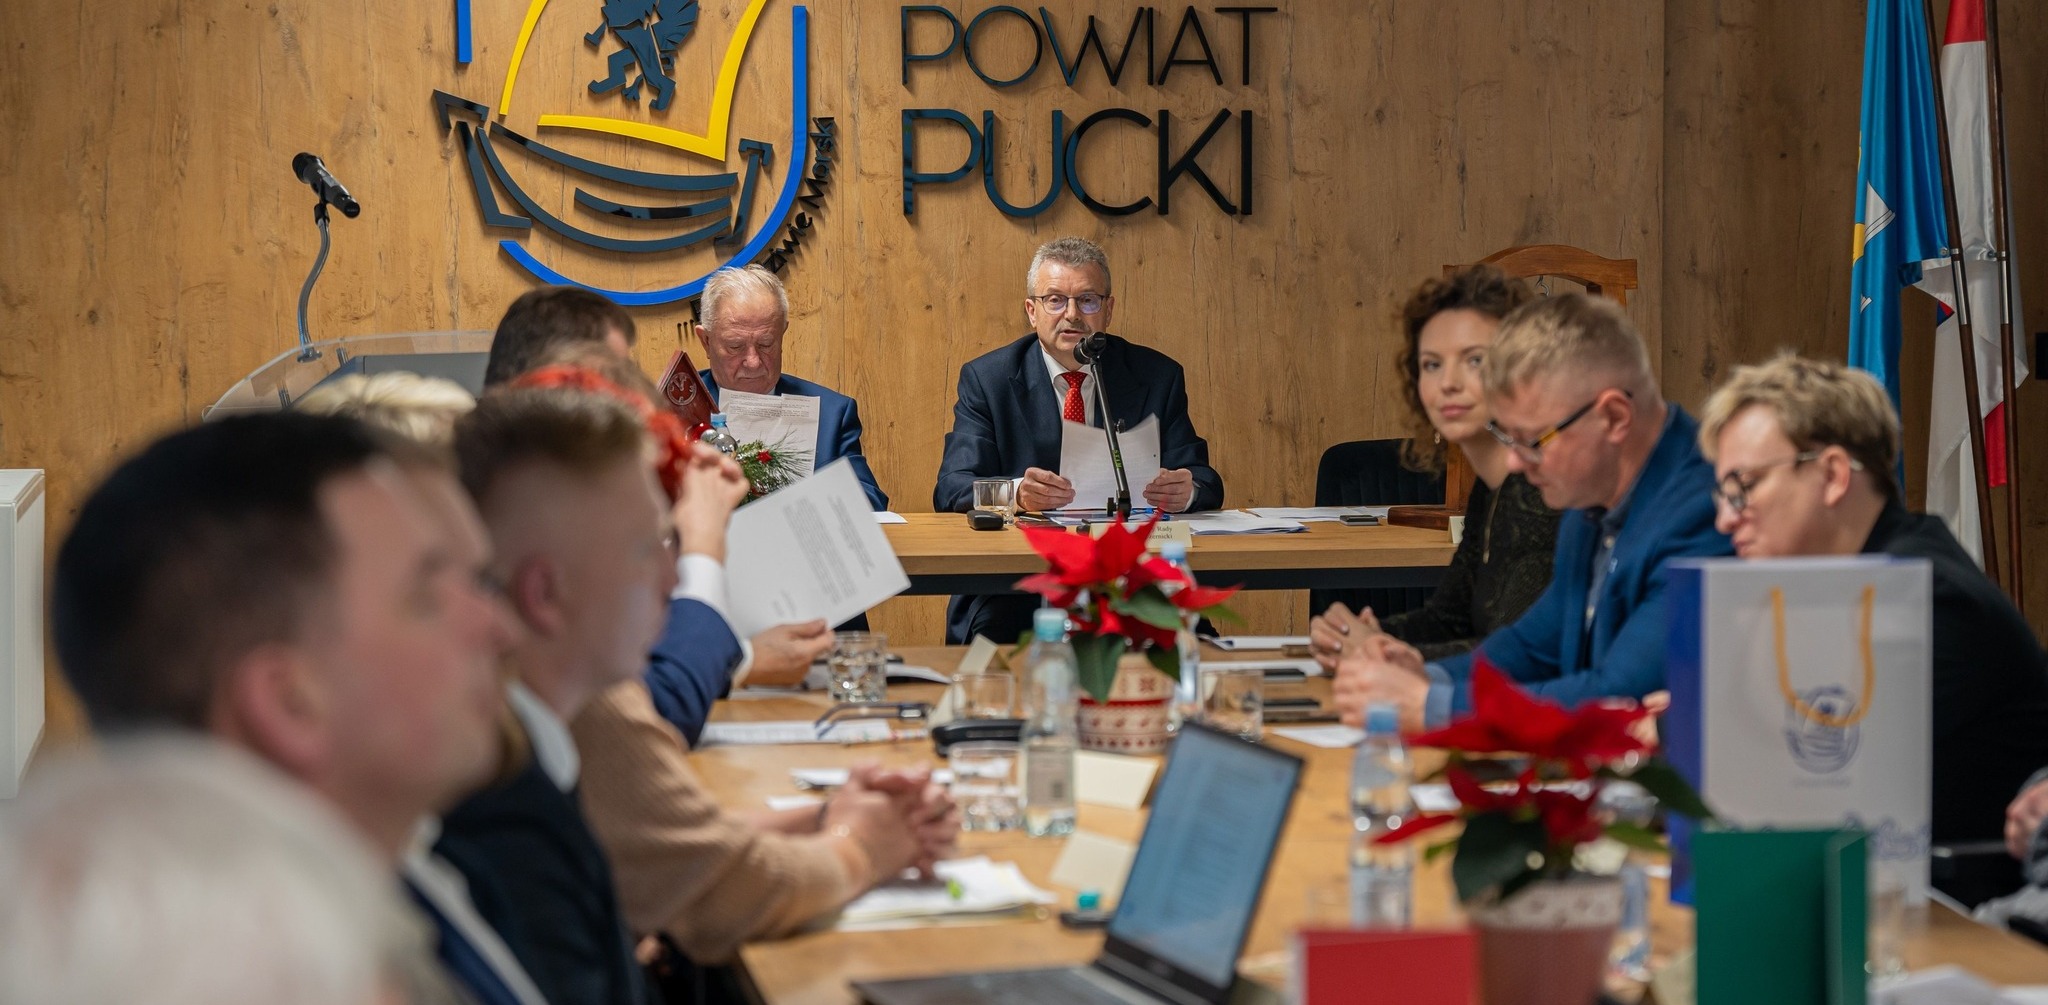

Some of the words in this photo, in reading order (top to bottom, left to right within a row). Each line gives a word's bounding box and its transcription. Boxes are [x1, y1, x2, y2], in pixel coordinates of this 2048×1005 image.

[902, 5, 1278, 87] POWIAT
[798, 117, 835, 209] Morski
[902, 108, 1253, 217] PUCKI
